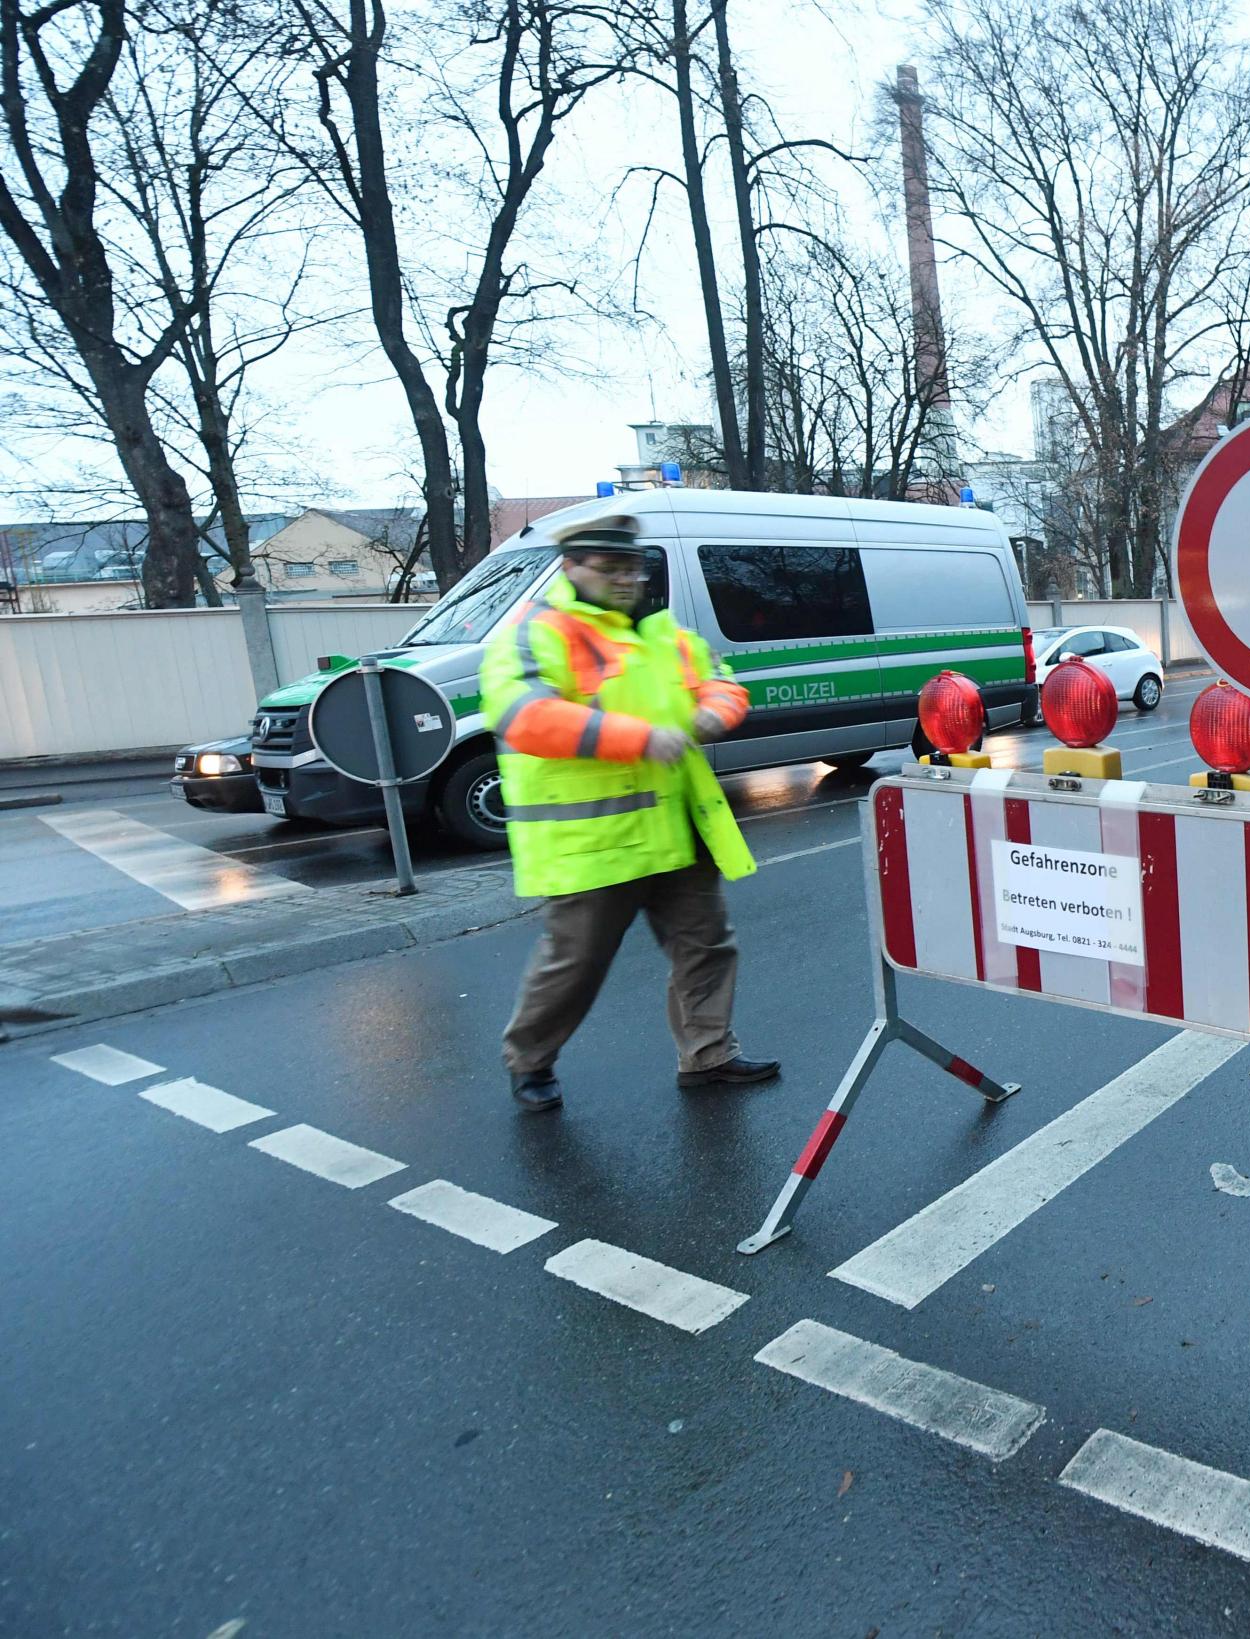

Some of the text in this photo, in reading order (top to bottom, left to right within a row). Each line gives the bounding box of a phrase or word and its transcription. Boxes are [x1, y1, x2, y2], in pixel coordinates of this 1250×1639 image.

[765, 681, 835, 702] POLIZEI
[1010, 850, 1118, 878] Gefahrenzone
[1002, 889, 1057, 910] Betreten
[1060, 901, 1122, 920] verboten
[1020, 927, 1055, 941] Augsburg,
[1057, 933, 1070, 943] Tel.
[1072, 936, 1090, 946] 0821
[1097, 939, 1112, 950] 324
